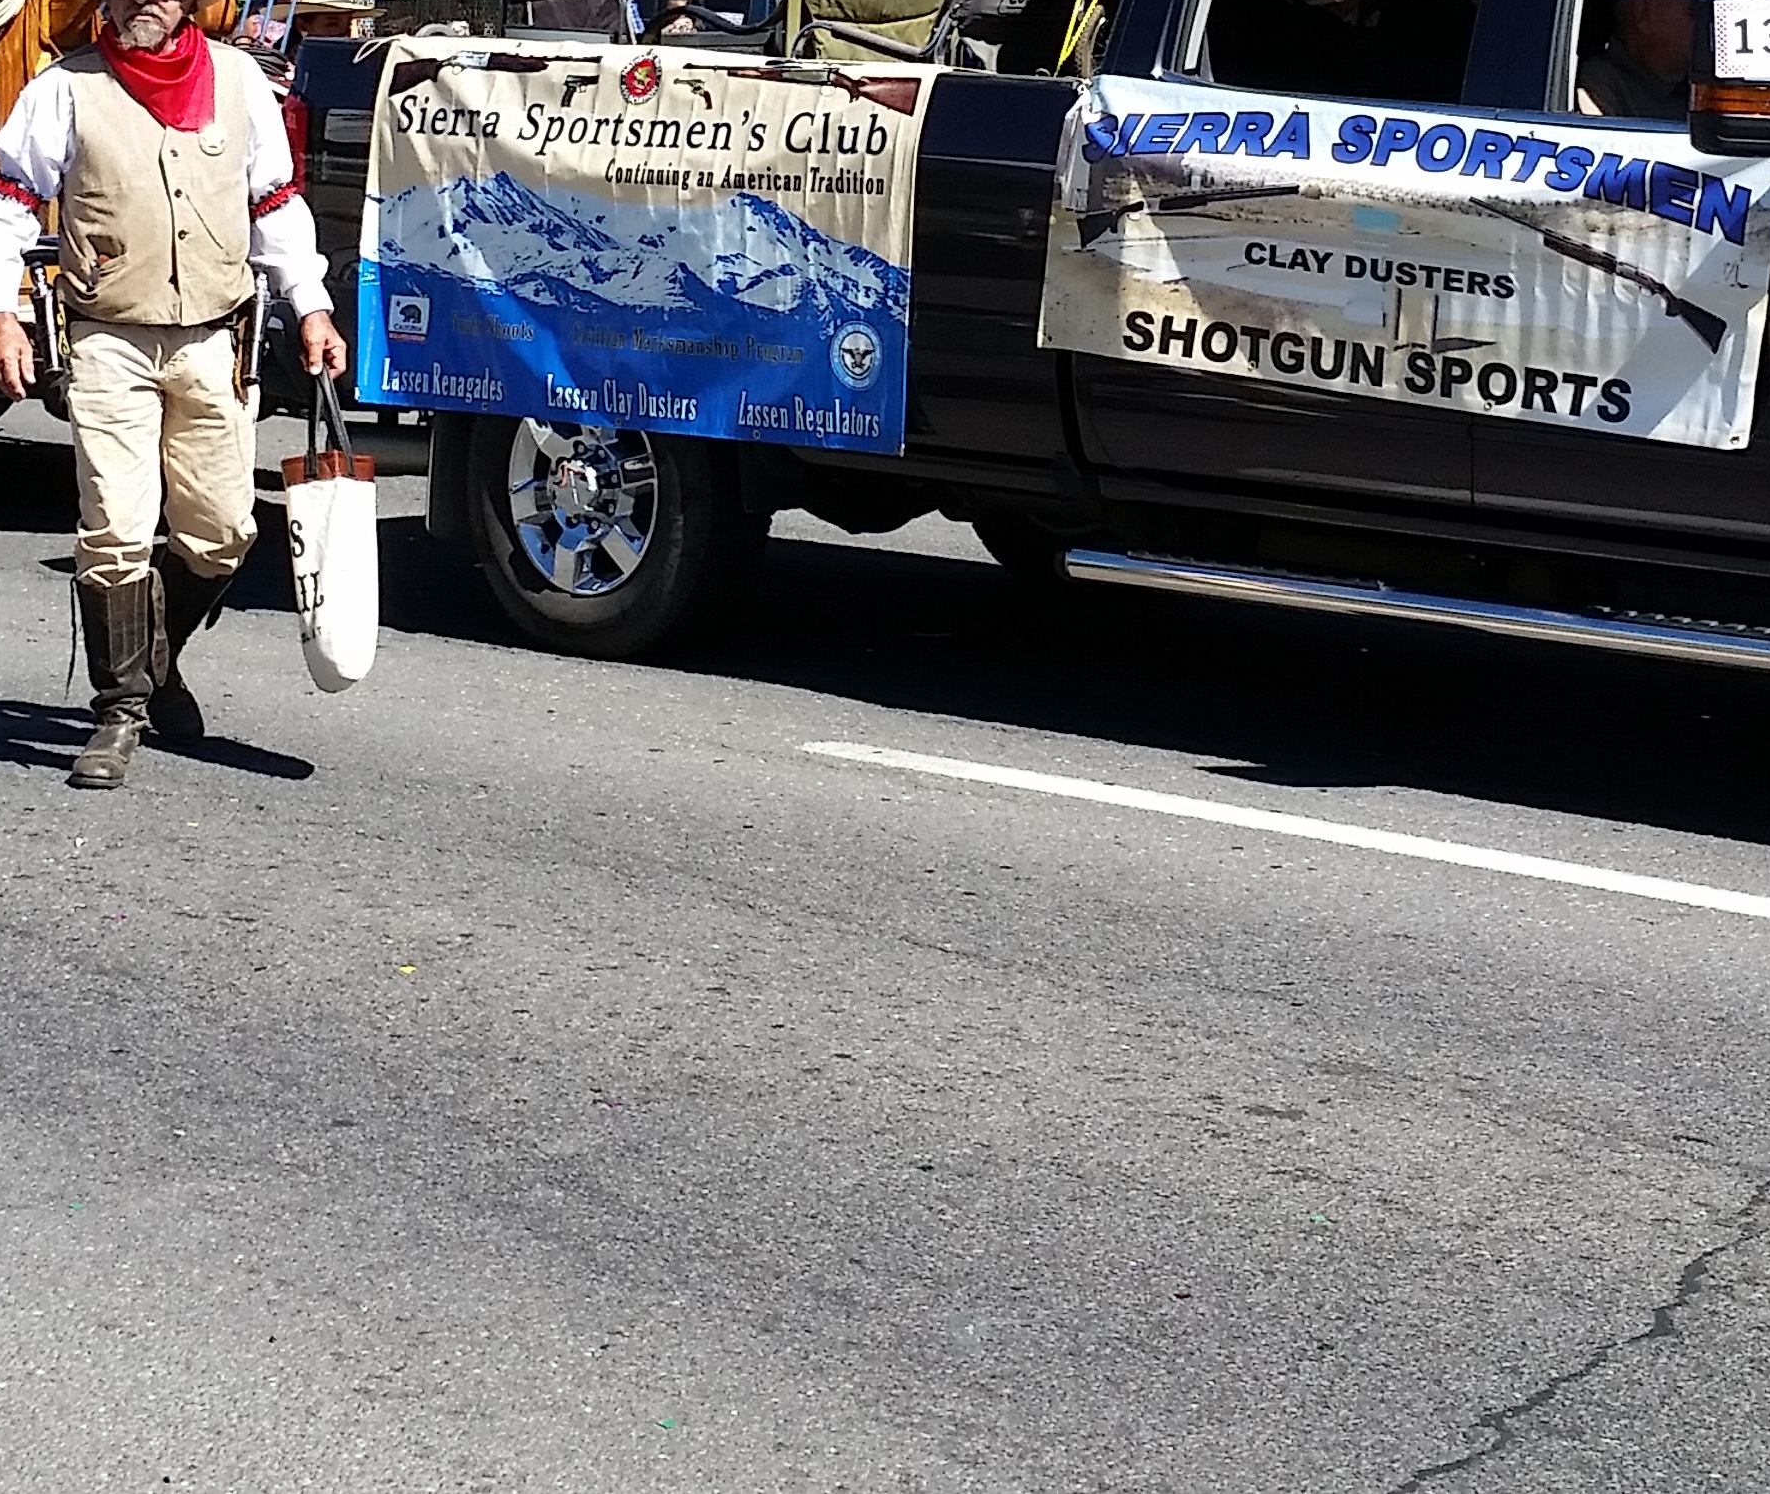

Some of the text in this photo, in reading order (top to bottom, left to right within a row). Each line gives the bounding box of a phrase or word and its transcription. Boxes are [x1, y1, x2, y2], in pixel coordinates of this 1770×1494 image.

[397, 94, 889, 156] Sierra Sportsmen's Club
[604, 157, 886, 196] Continuing an American Tradition
[1080, 109, 1754, 248] SIERRA SPORTSMEN
[1243, 241, 1517, 301] CLAY DUSTERS
[631, 325, 739, 362] Marksmanship
[745, 334, 804, 366] Program
[1121, 309, 1634, 425] SHOTGUN SPORTS
[381, 357, 505, 404] Lassen Renagades
[546, 373, 699, 422] Lassen Clay Dusters
[737, 390, 880, 439] Lassen Regulators
